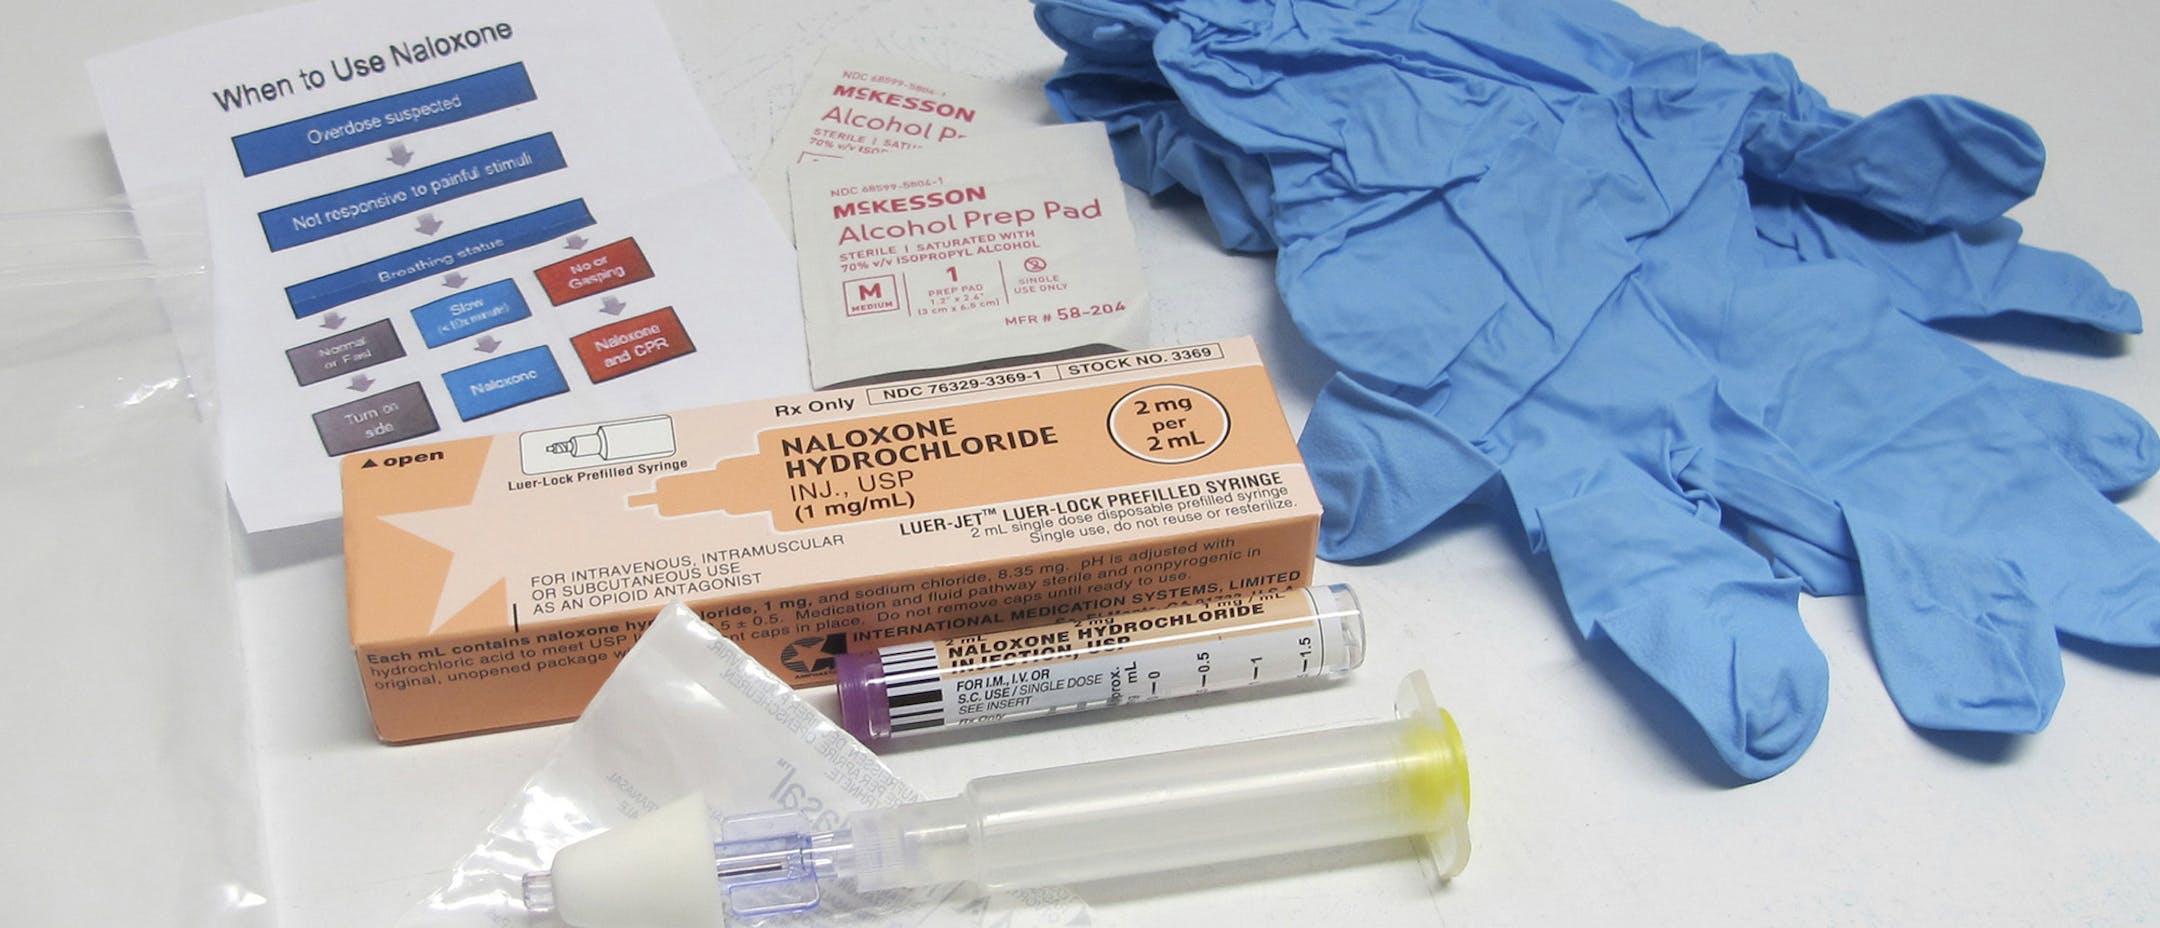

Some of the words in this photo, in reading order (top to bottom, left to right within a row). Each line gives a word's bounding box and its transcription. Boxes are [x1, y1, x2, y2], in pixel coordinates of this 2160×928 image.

[212, 77, 295, 113] When
[299, 68, 325, 91] to
[331, 54, 386, 82] Use
[389, 22, 513, 67] Naloxone
[842, 70, 868, 82] NDC
[307, 115, 382, 145] Overdose
[385, 94, 462, 126] suspected
[820, 105, 932, 140] Alcohol
[813, 128, 865, 144] STERILE
[325, 190, 408, 222] responsive
[411, 184, 428, 198] to
[430, 167, 481, 196] painful
[485, 152, 533, 176] stimuli
[830, 186, 859, 198] NDC
[838, 214, 957, 246] Alcohol
[964, 210, 1036, 229] Prep
[1044, 198, 1103, 220] Pad
[839, 246, 897, 262] STERILE
[917, 235, 996, 251] SATURATED
[999, 229, 1036, 240] WITH
[896, 247, 973, 265] ISOPROPYL
[977, 240, 1040, 256] ALCOHOL
[377, 252, 456, 283] Breathing
[568, 266, 626, 290] Gasping
[570, 261, 593, 275] No
[593, 256, 609, 270] or
[858, 282, 883, 301] M
[928, 285, 959, 297] PREP
[961, 283, 984, 292] PAD
[1014, 286, 1036, 295] USE
[1039, 282, 1069, 293] ONLY
[1018, 274, 1060, 285] SINGLE
[851, 300, 894, 312] MEDIUM
[1005, 314, 1039, 326] MFR
[1057, 300, 1127, 321] 58-204
[594, 324, 661, 351] Naloxone
[604, 350, 631, 368] and
[634, 337, 671, 358] CPR
[1067, 357, 1132, 375] STOCK
[1135, 354, 1168, 368] NO.
[1171, 346, 1212, 361] 3369
[470, 369, 538, 395] Naloxone
[883, 385, 924, 400] NDC
[927, 370, 1042, 395] 76329-3369-1
[343, 409, 380, 425] Turn
[775, 403, 802, 418] Rx
[808, 396, 855, 415] Only
[1135, 401, 1149, 415] 2
[1154, 396, 1194, 415] mg
[365, 422, 394, 439] side
[781, 418, 957, 457] NALOXONE
[1151, 415, 1188, 435] per
[785, 426, 1059, 479] HYDROCHLORIDE
[1146, 436, 1163, 452] 2
[1166, 430, 1206, 449] mL
[383, 449, 444, 469] open
[508, 473, 574, 491] Luer-Lock
[577, 465, 634, 482] Prefilled
[637, 458, 688, 475] Syringe
[858, 470, 915, 492] USP
[824, 490, 916, 517] mg/mL)
[1003, 496, 1104, 521] LUER-LOCK
[1108, 482, 1201, 508] PREFILLED
[1205, 471, 1283, 494] SYRINGE
[984, 525, 1008, 537] mL
[1011, 517, 1055, 533] single
[1057, 512, 1093, 526] dose
[1097, 501, 1173, 523] disposable
[1177, 492, 1234, 512] prefilled
[1237, 485, 1288, 505] syringe
[1030, 528, 1075, 545] Single
[1131, 515, 1151, 529] not
[1154, 511, 1203, 526] reuse
[1225, 498, 1297, 517] resterilize.
[531, 574, 565, 587] FOR
[701, 534, 844, 564] INTRAMUSCULAR
[531, 587, 556, 601] OR
[562, 568, 702, 599] SUBCUTANEOUS
[707, 563, 740, 576] USE
[533, 602, 555, 615] AS
[561, 597, 583, 611] AN
[589, 589, 648, 606] OPIOID
[653, 573, 762, 598] ANTAGONIST
[367, 651, 412, 665] Each
[417, 648, 446, 660] mL
[451, 636, 531, 655] contains
[536, 624, 619, 644] naloxone
[818, 590, 849, 605] and
[855, 581, 915, 599] sodium
[998, 565, 1034, 580] 8.35
[1081, 555, 1104, 571] pH
[1128, 544, 1197, 563] adjusted
[1203, 537, 1236, 551] with
[369, 655, 474, 678] hydrochloric
[479, 650, 515, 665] acid
[541, 642, 584, 657] meet
[589, 633, 627, 649] USP
[796, 599, 886, 620] Medication
[891, 595, 923, 607] and
[928, 587, 963, 602] fluid
[968, 579, 1036, 598] pathway
[1043, 570, 1093, 588] sterile
[1099, 565, 1128, 579] and
[1133, 551, 1242, 577] nonpyrogenic
[1247, 547, 1262, 560] in
[853, 614, 1001, 643] INTERNATIONAL
[1018, 596, 1125, 620] MEDICATION
[1228, 570, 1301, 592] LIMITED
[447, 662, 532, 682] unopened
[536, 650, 608, 672] package
[751, 626, 790, 641] caps
[816, 616, 865, 633] place.
[877, 611, 901, 623] Do
[906, 605, 933, 618] not
[937, 598, 999, 615] remove
[1087, 580, 1132, 598] ready
[949, 631, 1070, 658] NALOXONE
[1077, 603, 1265, 641] HYDROCHLORIDE
[956, 679, 983, 692] FOR
[1012, 671, 1028, 684] I.V.
[1031, 668, 1050, 681] OR
[1124, 661, 1137, 684] mL
[958, 692, 982, 704] S.C.
[984, 688, 1010, 702] USE
[1019, 679, 1065, 695] SINGLE
[1066, 674, 1103, 688] DOSE
[959, 704, 983, 715] SEE
[986, 696, 1032, 710] INSERT
